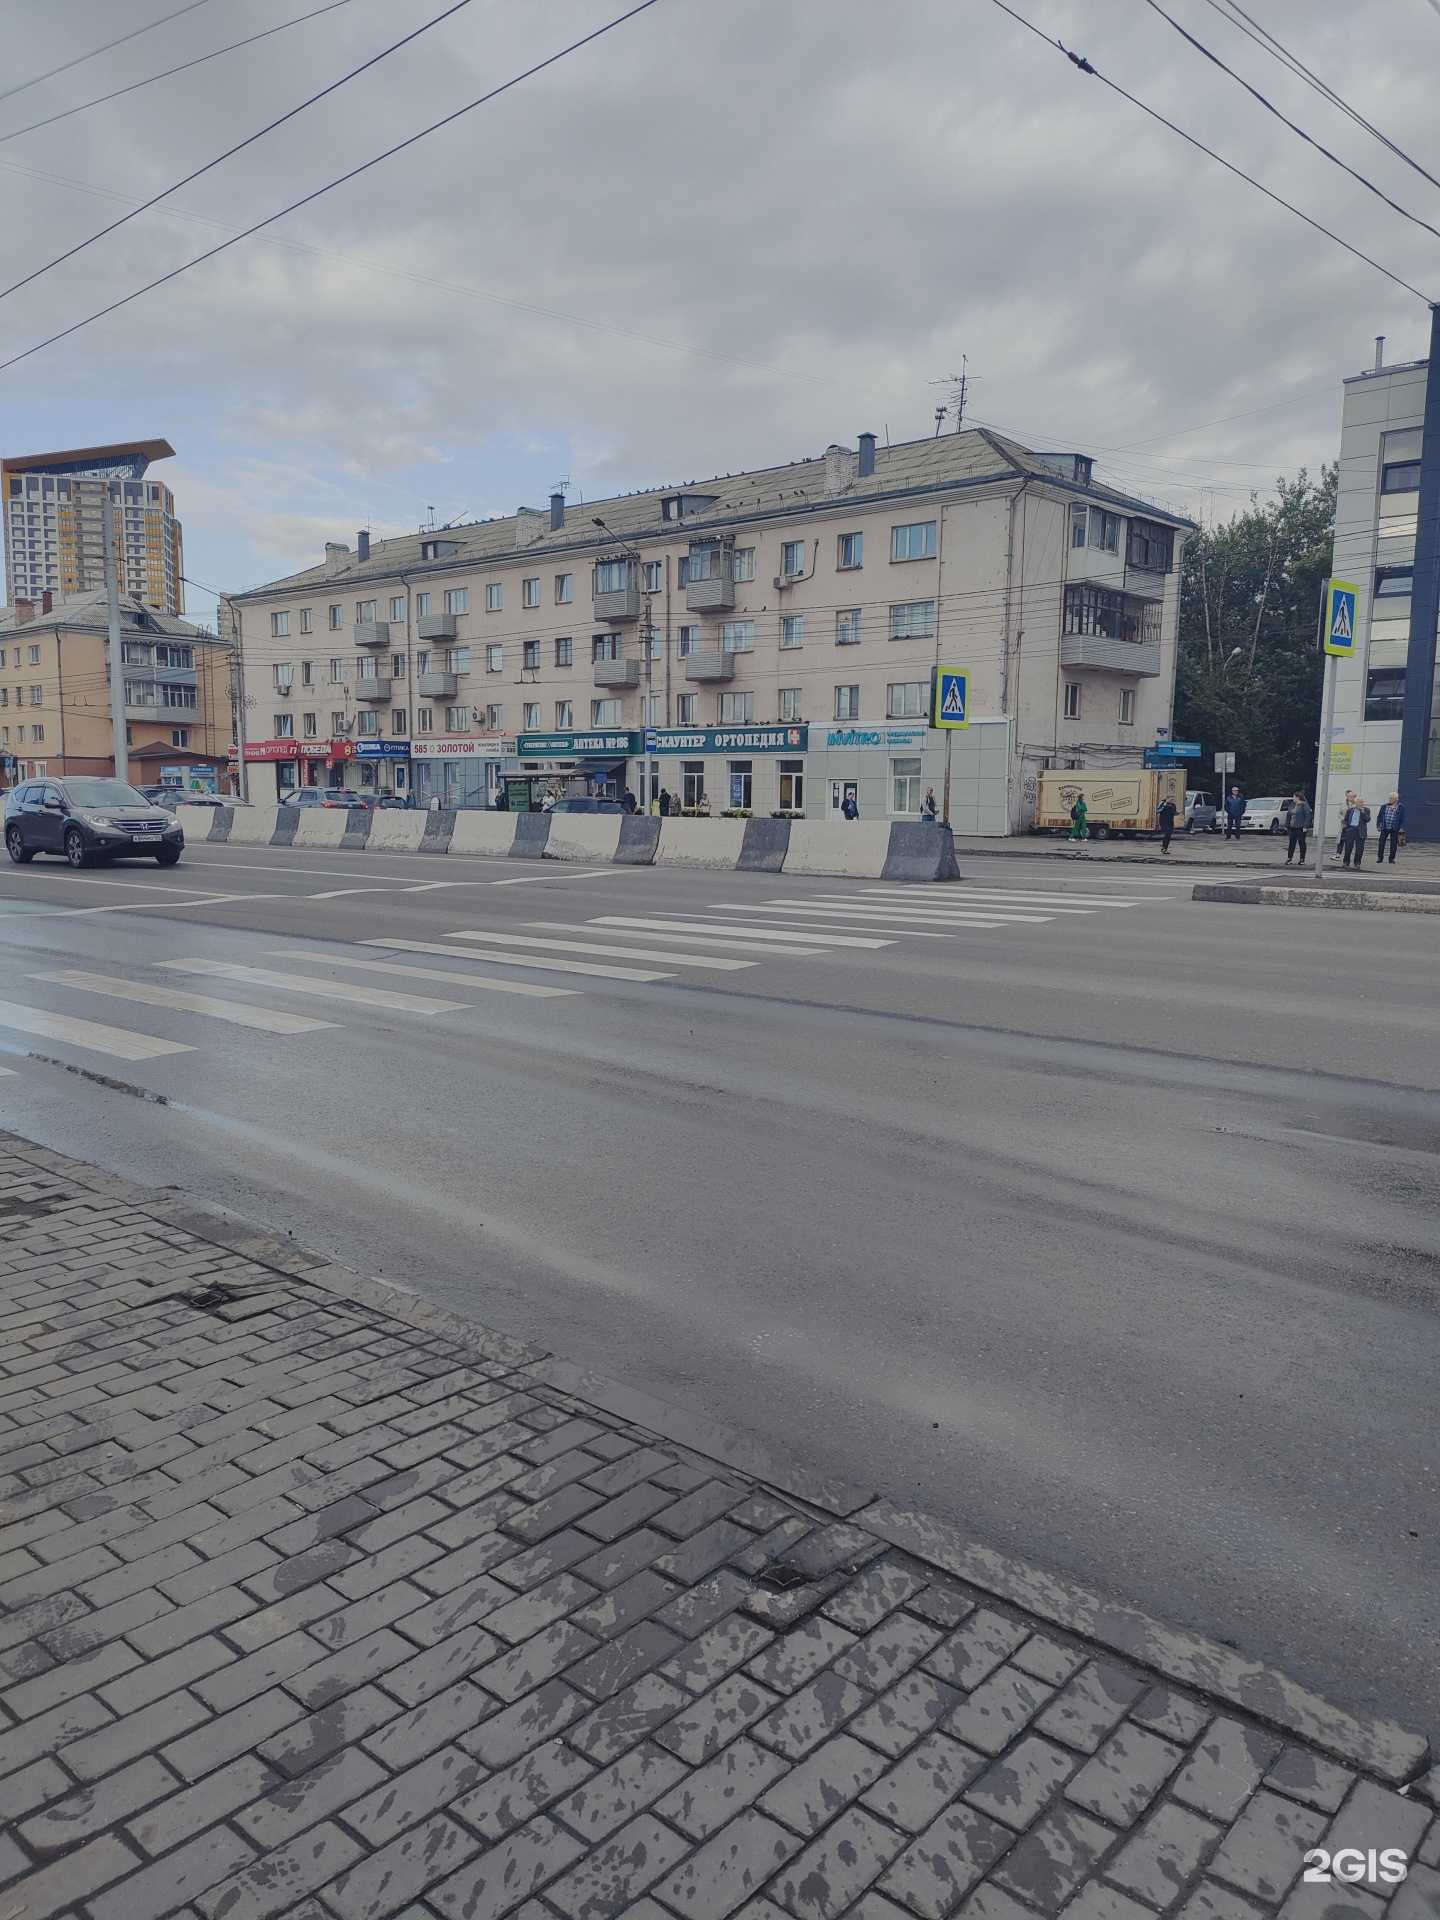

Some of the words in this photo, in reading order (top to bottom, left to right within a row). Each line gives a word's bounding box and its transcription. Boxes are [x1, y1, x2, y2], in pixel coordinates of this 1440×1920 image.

[573, 738, 604, 750] АПТЕКА
[656, 735, 706, 748] СКАУНТЕР
[714, 733, 784, 748] ОРТОПЕДИЯ
[414, 744, 428, 754] 585
[437, 741, 475, 753] ЗОЛОТОЙ
